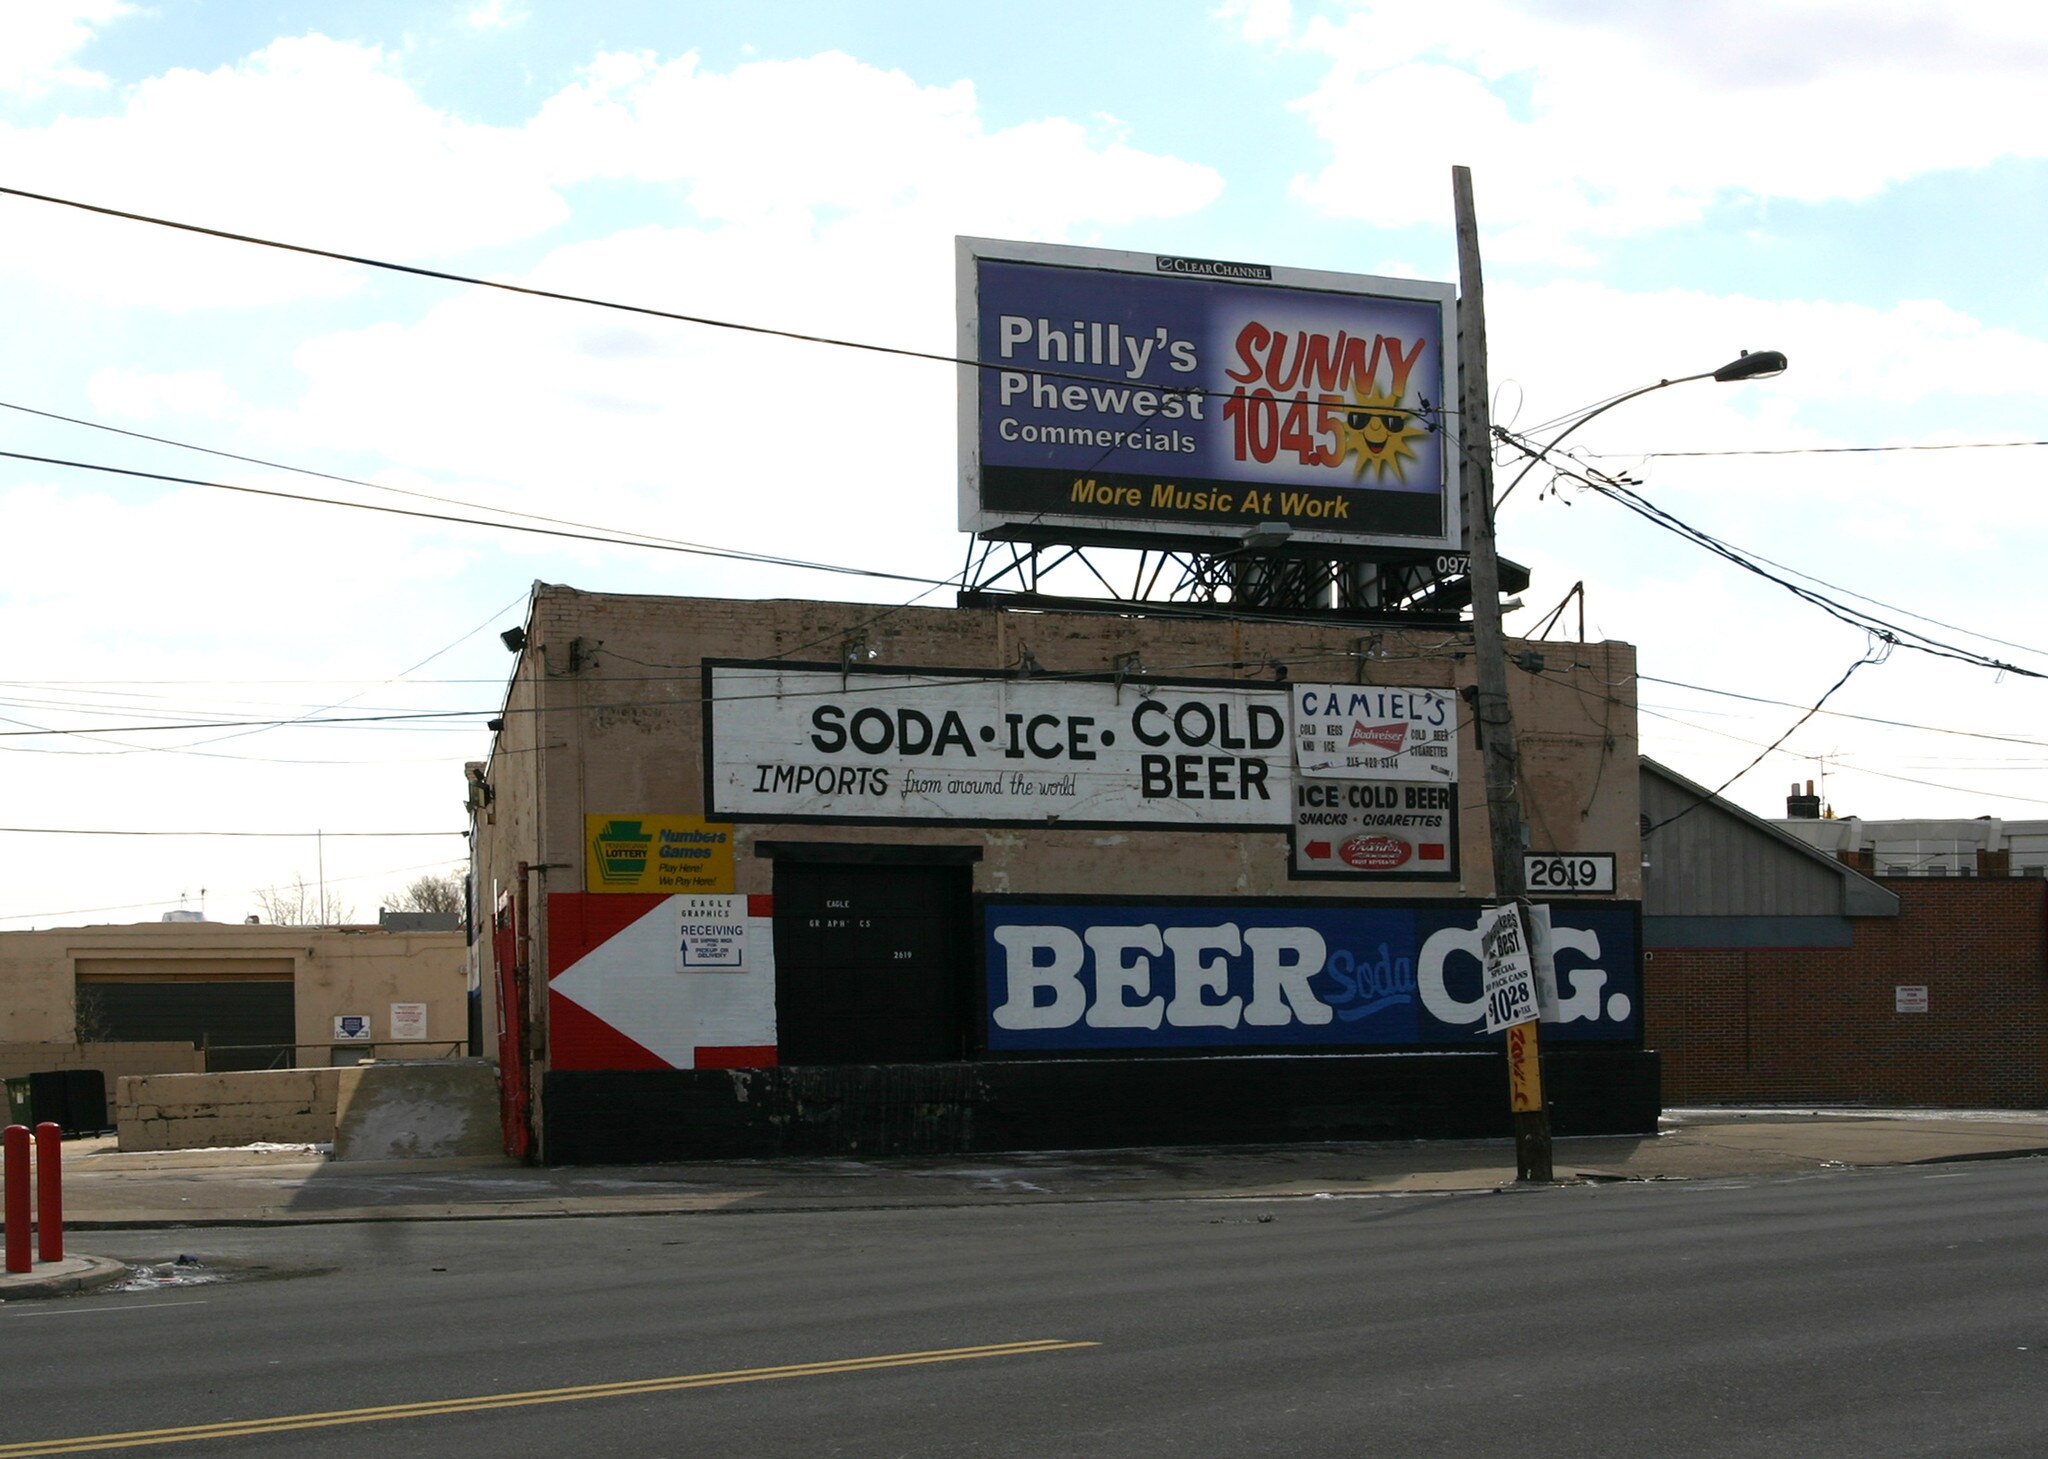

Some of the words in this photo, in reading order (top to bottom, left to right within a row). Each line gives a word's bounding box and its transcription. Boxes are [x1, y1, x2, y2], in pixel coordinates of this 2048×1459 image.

[1000, 314, 1198, 380] Philly's
[1225, 320, 1426, 397] SUNNY
[1000, 371, 1204, 421] Phewest
[998, 418, 1197, 454] Commercials
[1071, 478, 1142, 508] More
[1151, 483, 1232, 513] Music
[1240, 489, 1274, 516] At
[1280, 491, 1350, 521] Work
[1302, 692, 1445, 726] CAMIEL'S
[811, 704, 976, 758] SODA
[1005, 713, 1096, 760] ICE
[1131, 700, 1284, 749] COLD
[1300, 724, 1317, 735] COLD
[1327, 724, 1343, 736] KEGS
[1352, 728, 1403, 742] Budweiser
[1411, 729, 1427, 741] COLD
[1433, 729, 1449, 741] BEER
[1303, 740, 1315, 751] AND
[1324, 741, 1335, 752] ICE
[753, 764, 889, 797] IMPORTS
[901, 769, 942, 800] from
[948, 771, 1003, 795] around
[1009, 771, 1034, 796] the
[1038, 772, 1077, 797] world
[1141, 754, 1270, 801] BEER
[1298, 785, 1339, 808] ICE
[1349, 786, 1399, 809] COLD
[1405, 787, 1450, 810] BEER
[1298, 813, 1348, 826] SNACKS
[1363, 814, 1443, 828] CIGARETTES
[658, 829, 727, 843] Numbers
[605, 849, 647, 858] LOTTERY
[659, 844, 712, 859] Games
[659, 863, 678, 874] Play
[679, 863, 704, 873] Here!
[1531, 860, 1596, 886] 2619
[659, 876, 673, 885] We
[675, 877, 690, 887] Pay
[692, 877, 717, 886] Here!
[826, 900, 850, 908] EAGLE
[681, 910, 729, 918] GRAPHICS
[680, 925, 743, 936] RECEIVING
[894, 951, 912, 959] 2619
[993, 922, 1333, 1030] BEER
[1326, 944, 1416, 999] Soda
[1490, 963, 1517, 979] SPECIAL
[1508, 969, 1529, 984] CANS
